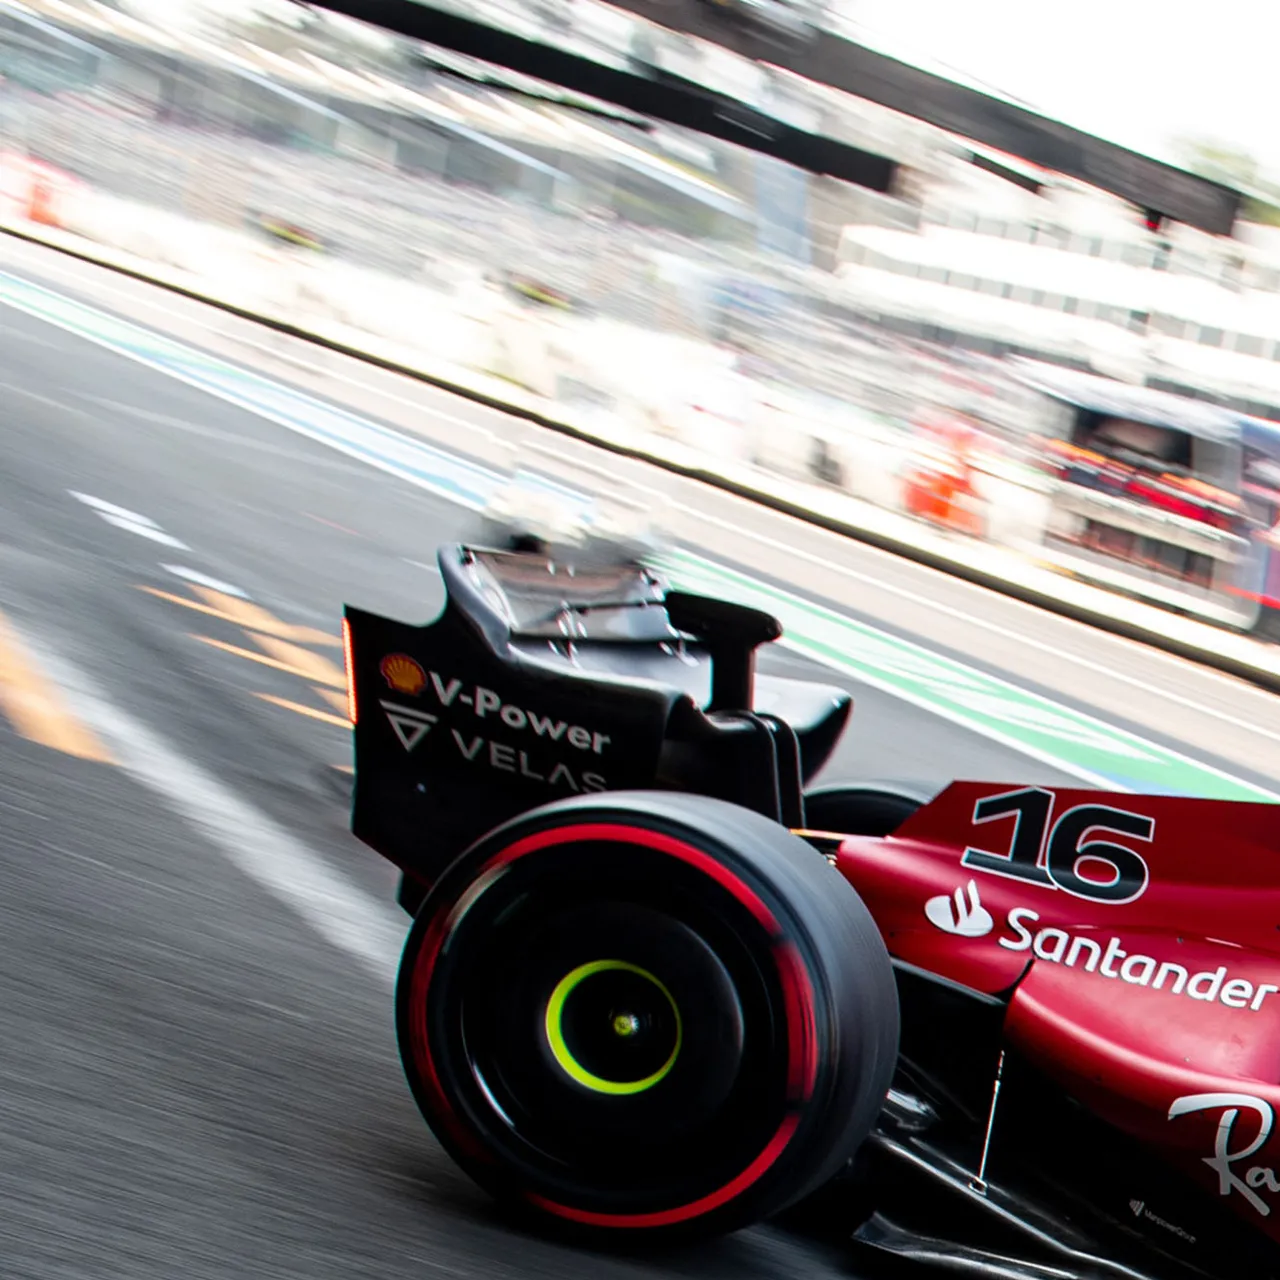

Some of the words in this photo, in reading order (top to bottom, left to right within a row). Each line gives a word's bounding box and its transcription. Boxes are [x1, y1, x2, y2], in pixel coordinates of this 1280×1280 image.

[429, 671, 611, 754] V-Power
[451, 728, 607, 793] VELAS
[961, 786, 1155, 905] 16
[998, 907, 1279, 1010] Santander
